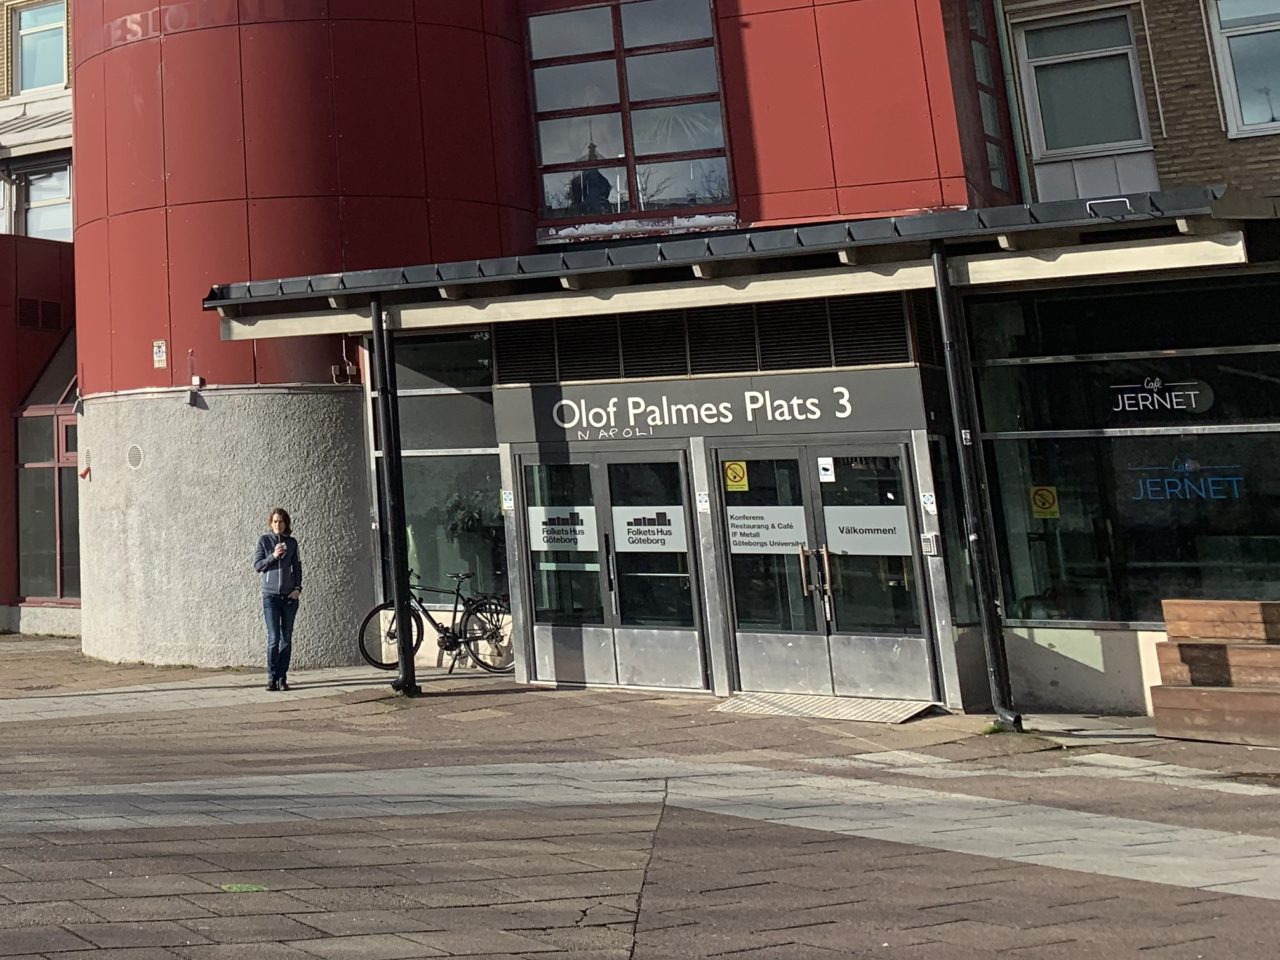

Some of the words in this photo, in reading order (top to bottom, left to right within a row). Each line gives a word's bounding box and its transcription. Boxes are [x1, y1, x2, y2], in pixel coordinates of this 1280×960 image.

[1113, 391, 1200, 411] JERNET
[552, 397, 618, 428] Olof
[627, 395, 733, 426] Palmes
[744, 390, 821, 422] Plats
[832, 387, 853, 418] 3
[1131, 477, 1244, 500] JERNET
[542, 528, 569, 536] Folkets
[570, 528, 585, 536] Hus
[627, 528, 656, 536] Folkets
[657, 528, 673, 536] Hus
[838, 526, 897, 535] Välkommen!
[542, 536, 578, 545] Göteborg
[628, 536, 666, 546] Göteborg
[732, 540, 768, 548] Göteborgs
